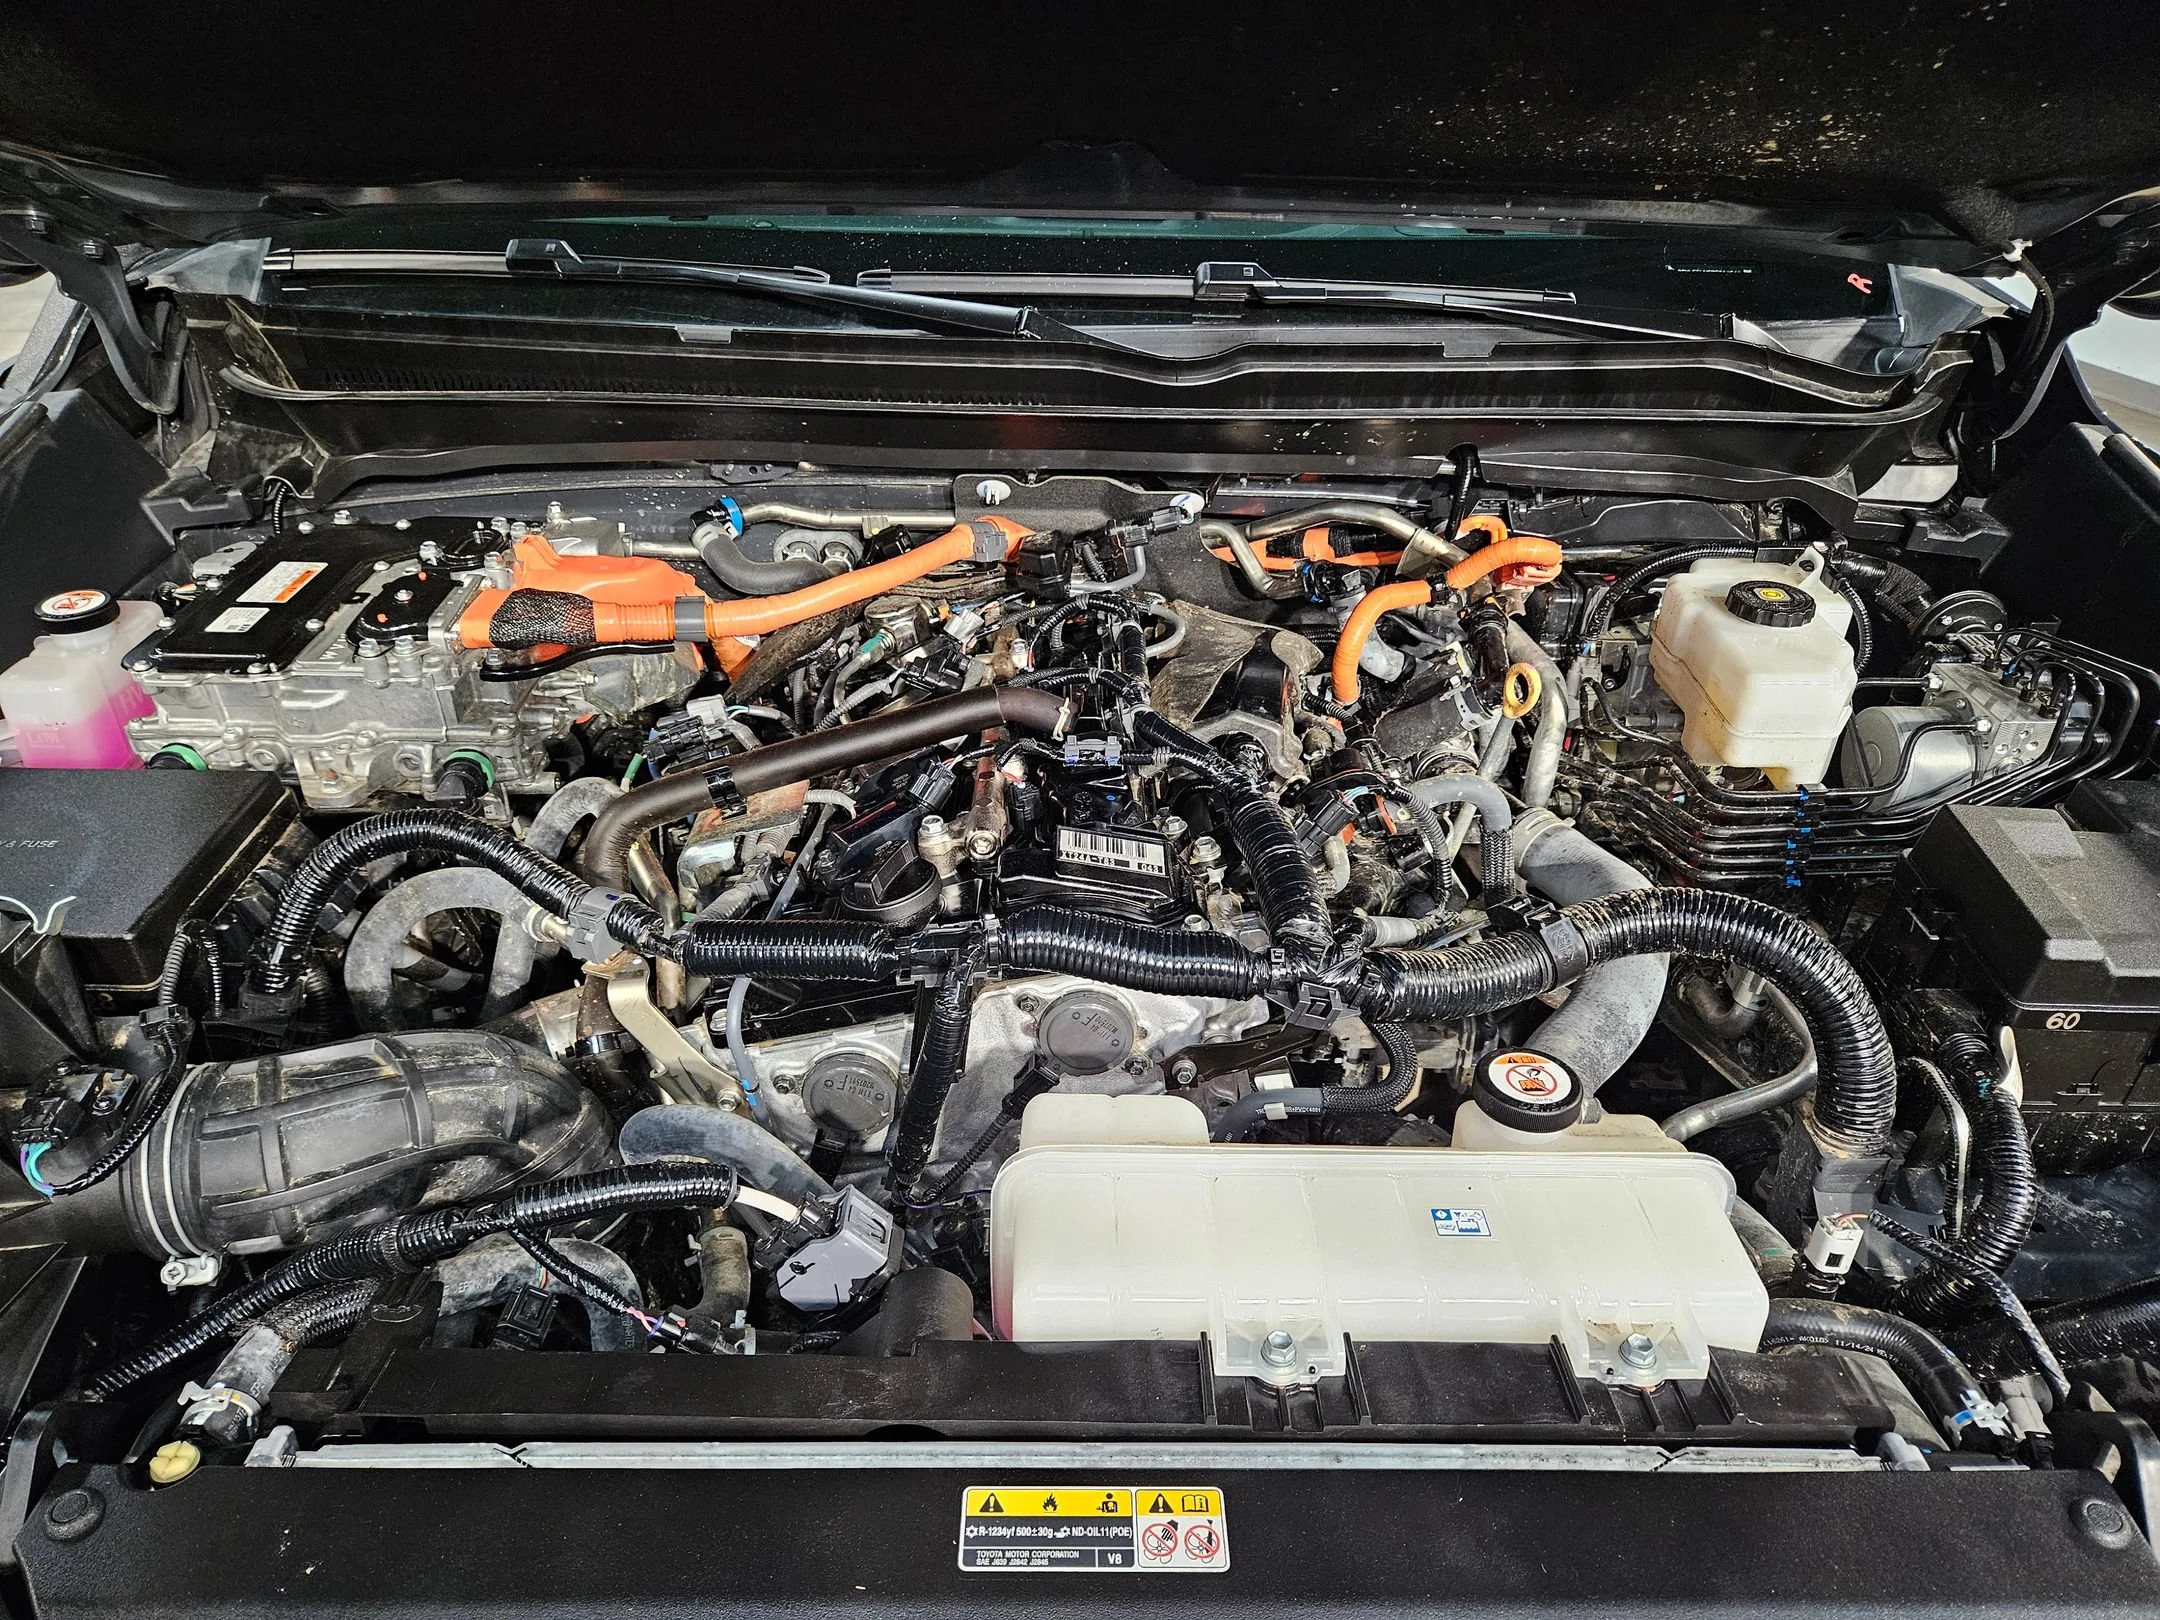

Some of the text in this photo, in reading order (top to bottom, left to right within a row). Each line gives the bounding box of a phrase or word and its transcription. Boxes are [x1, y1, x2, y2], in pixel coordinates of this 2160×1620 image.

[1847, 273, 1873, 294] R
[19, 840, 58, 848] FUSE
[2046, 1012, 2080, 1030] 60
[1835, 1340, 1874, 1353] 11/14/24
[978, 1526, 1133, 1539] R-1234yf 500±30g ND-OIL11(POE)
[976, 1550, 1080, 1558] TOYOTA MOTOR CORPORATION
[1107, 1553, 1122, 1564] V8
